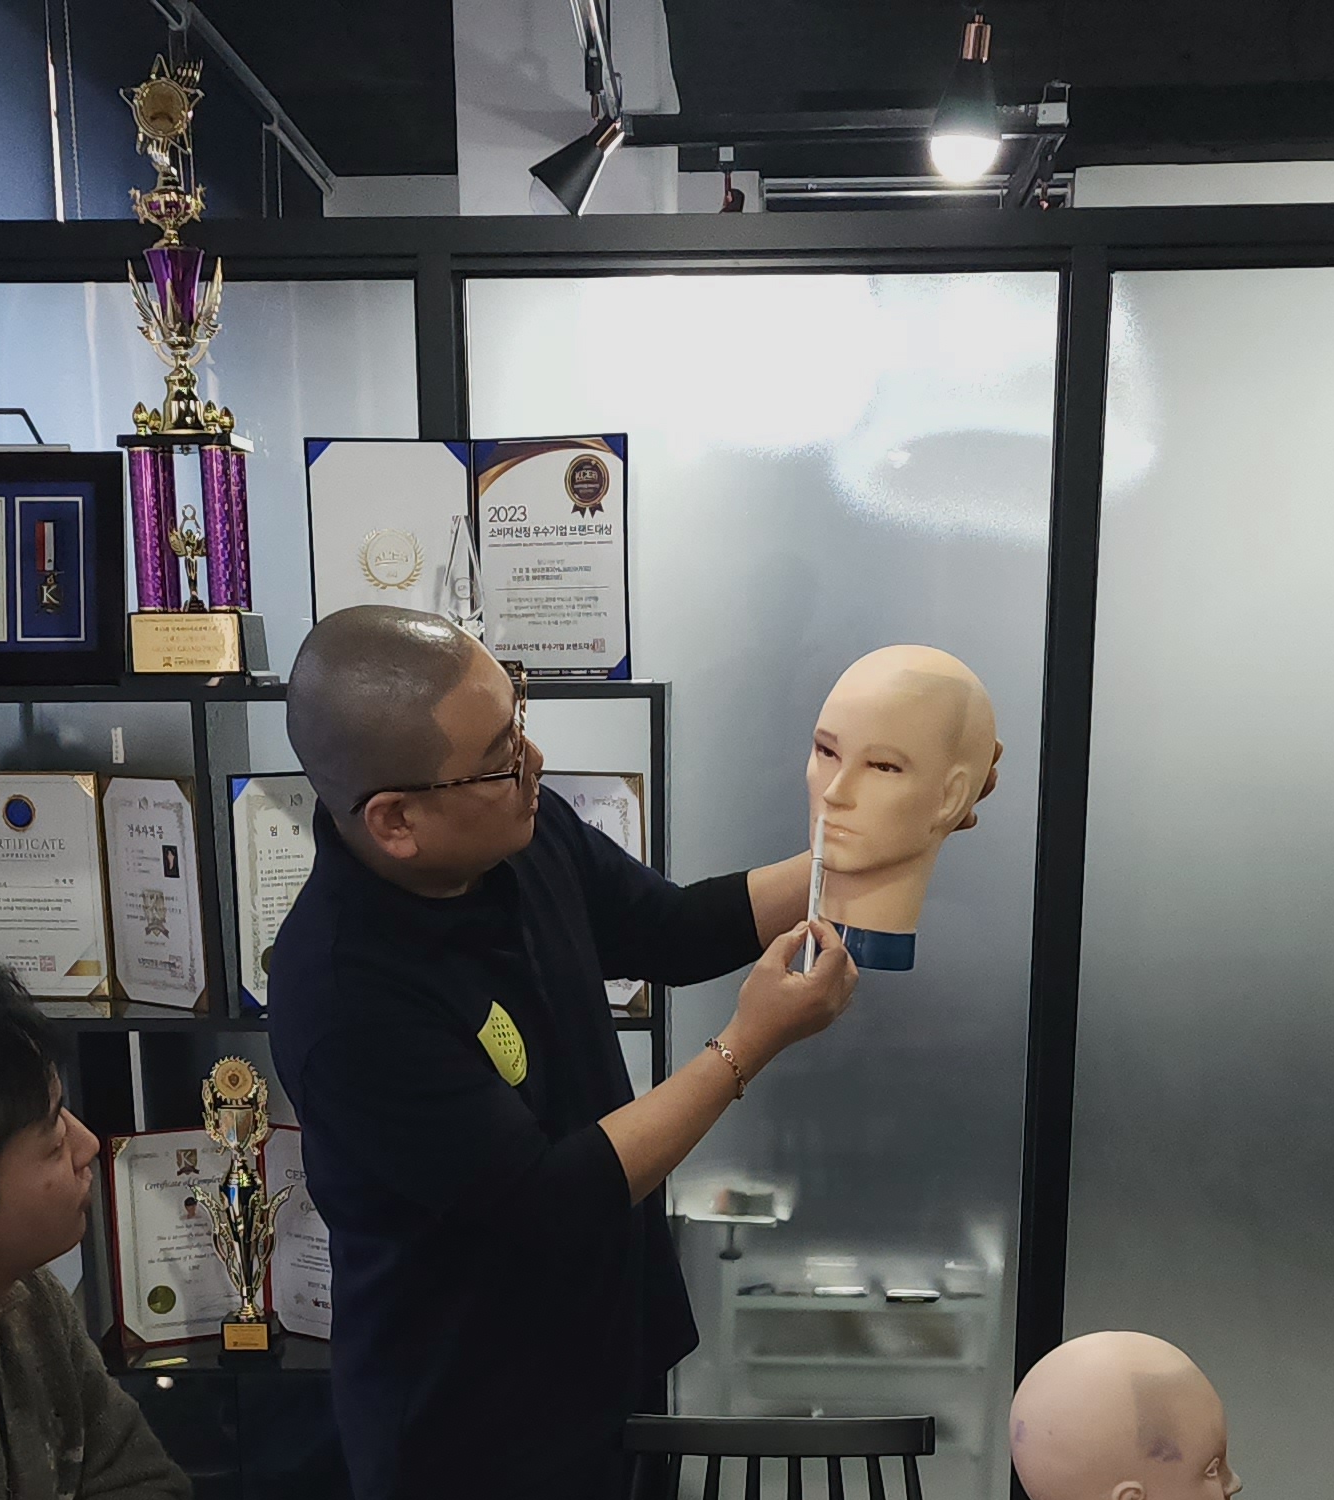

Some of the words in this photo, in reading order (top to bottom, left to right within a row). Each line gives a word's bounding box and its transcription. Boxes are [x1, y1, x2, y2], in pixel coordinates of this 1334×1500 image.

[488, 505, 528, 523] 2023
[532, 524, 568, 537] 우수기업
[569, 523, 613, 536] 브랜드대상
[41, 584, 61, 606] K
